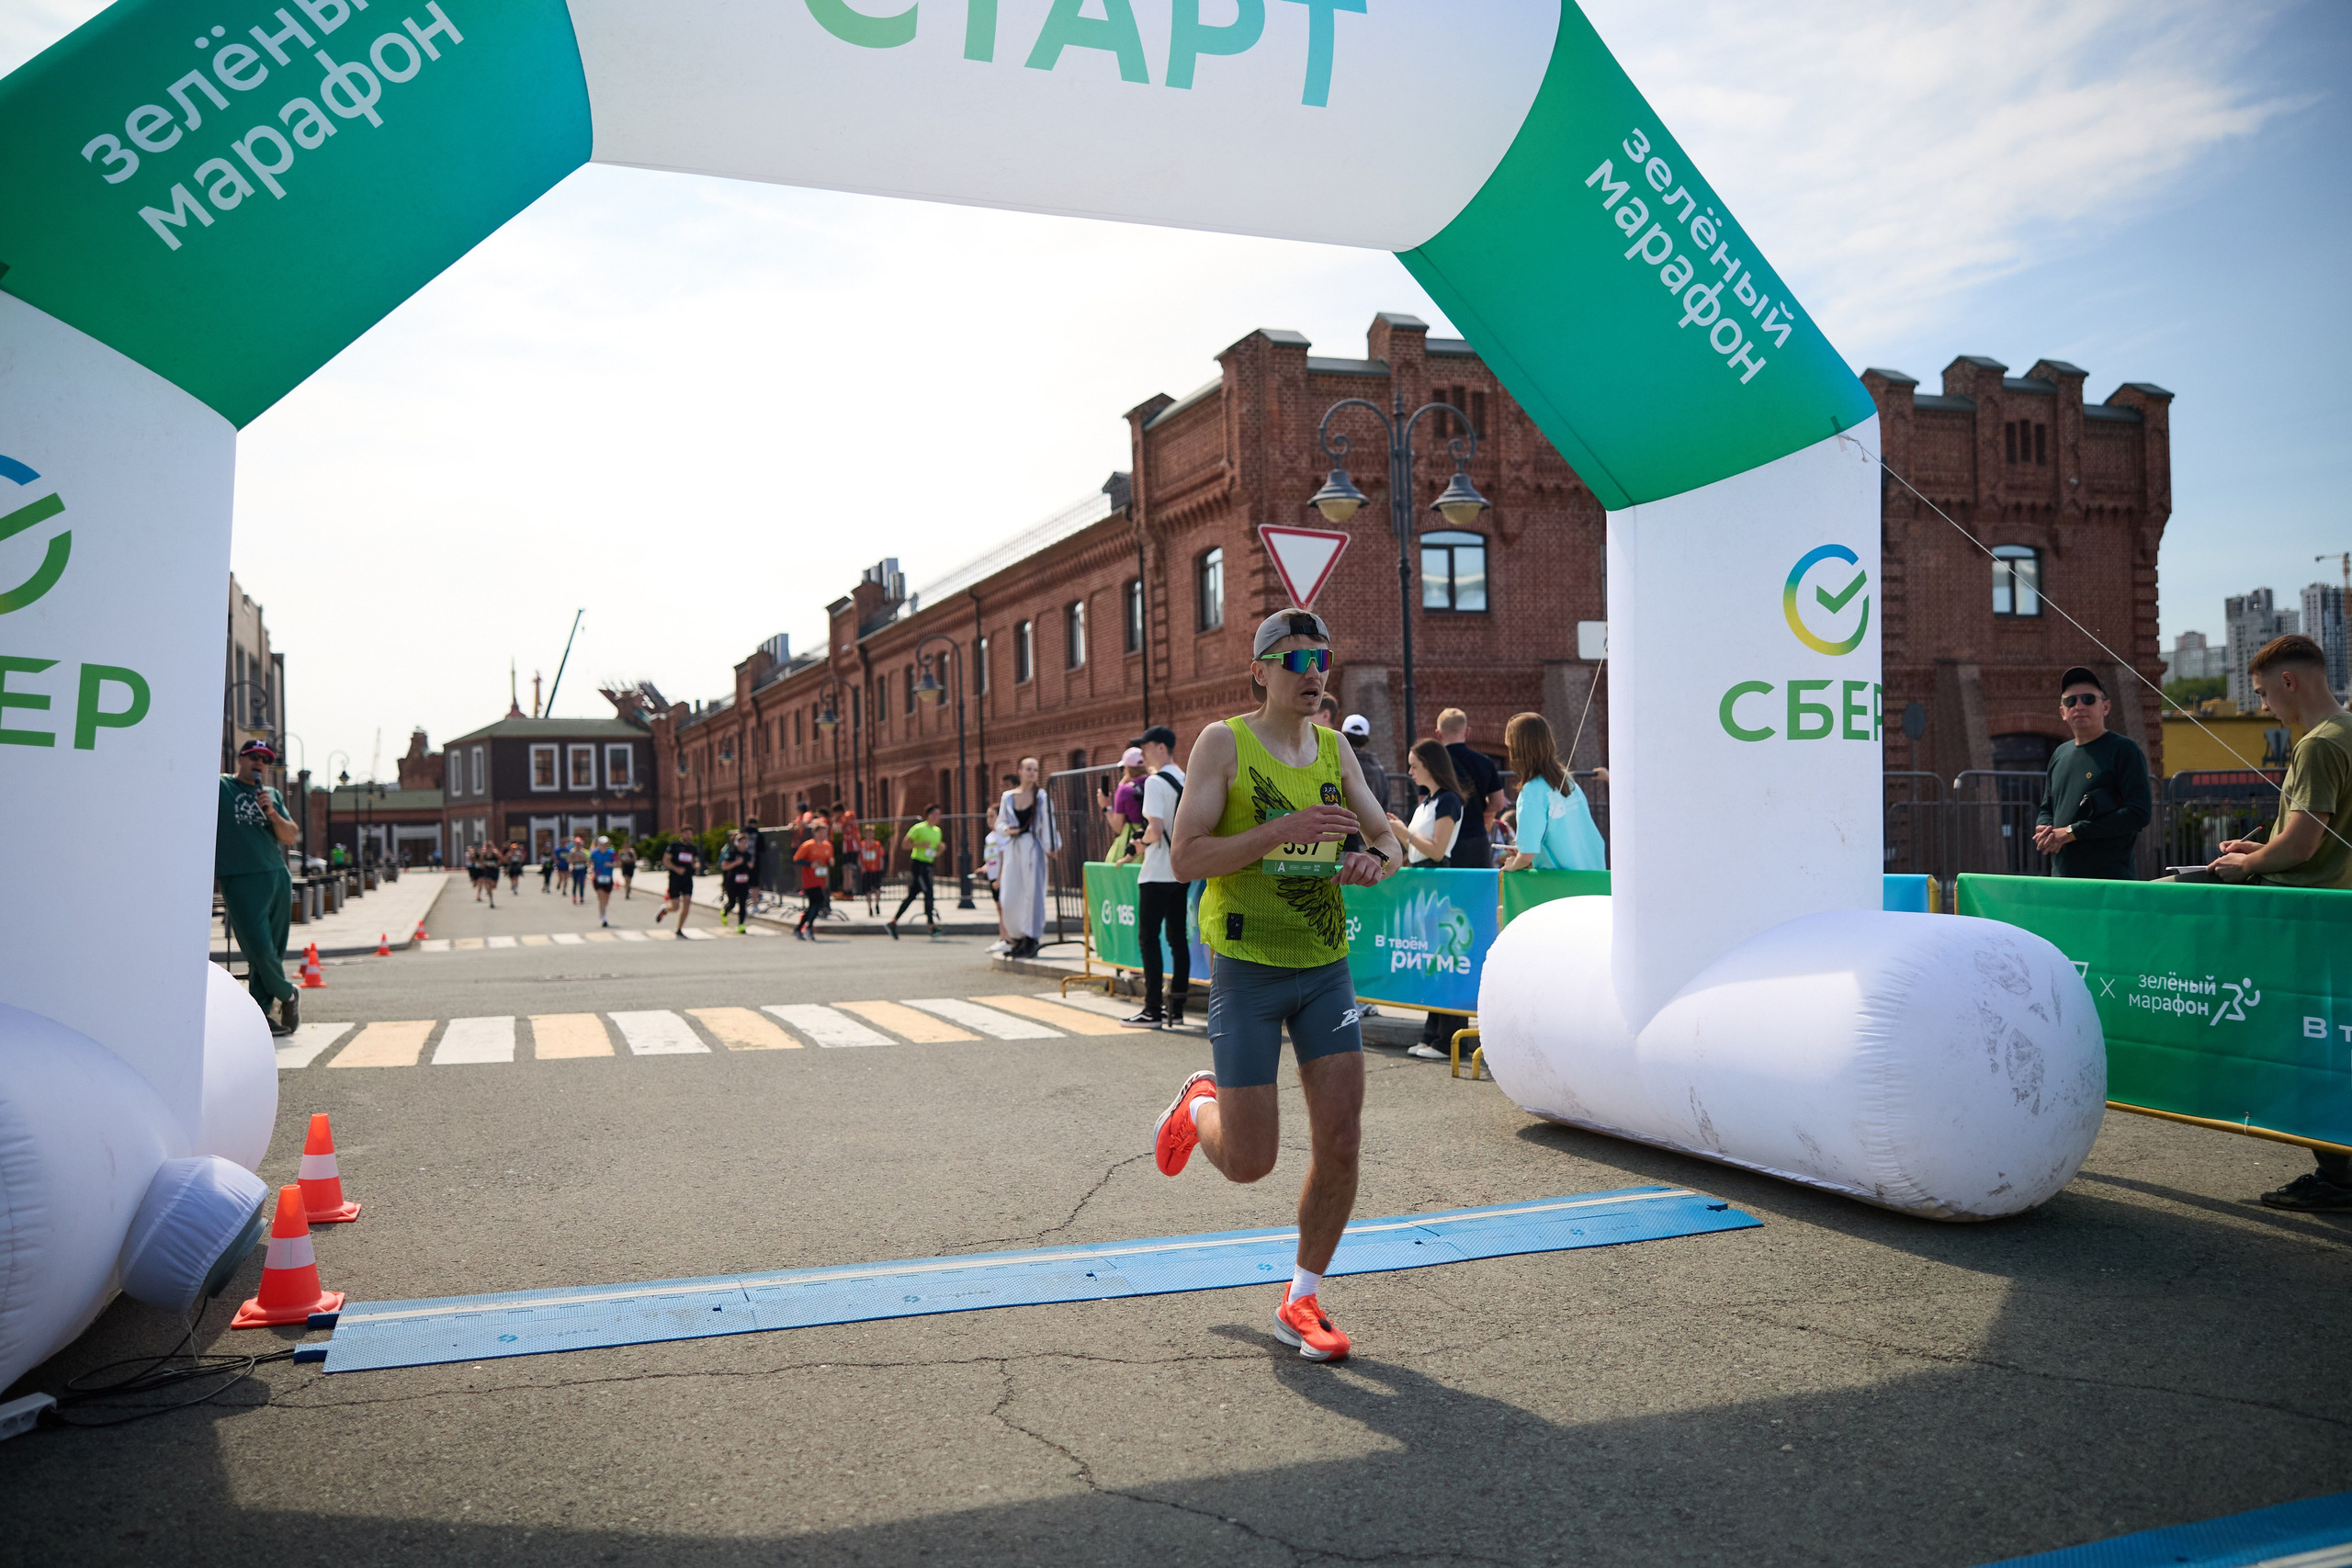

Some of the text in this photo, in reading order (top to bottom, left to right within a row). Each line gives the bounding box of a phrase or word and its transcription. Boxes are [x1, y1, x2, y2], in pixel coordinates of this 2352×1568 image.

[137, 0, 465, 251] марафон
[1622, 128, 1794, 349] зелёный
[1584, 158, 1767, 386] марафон
[1116, 904, 1136, 927] 185
[1375, 934, 1429, 951] В твоём
[1390, 950, 1472, 976] ритме
[2138, 971, 2217, 996] зелёный
[2128, 993, 2209, 1018] марафон
[2303, 1016, 2328, 1039] В
